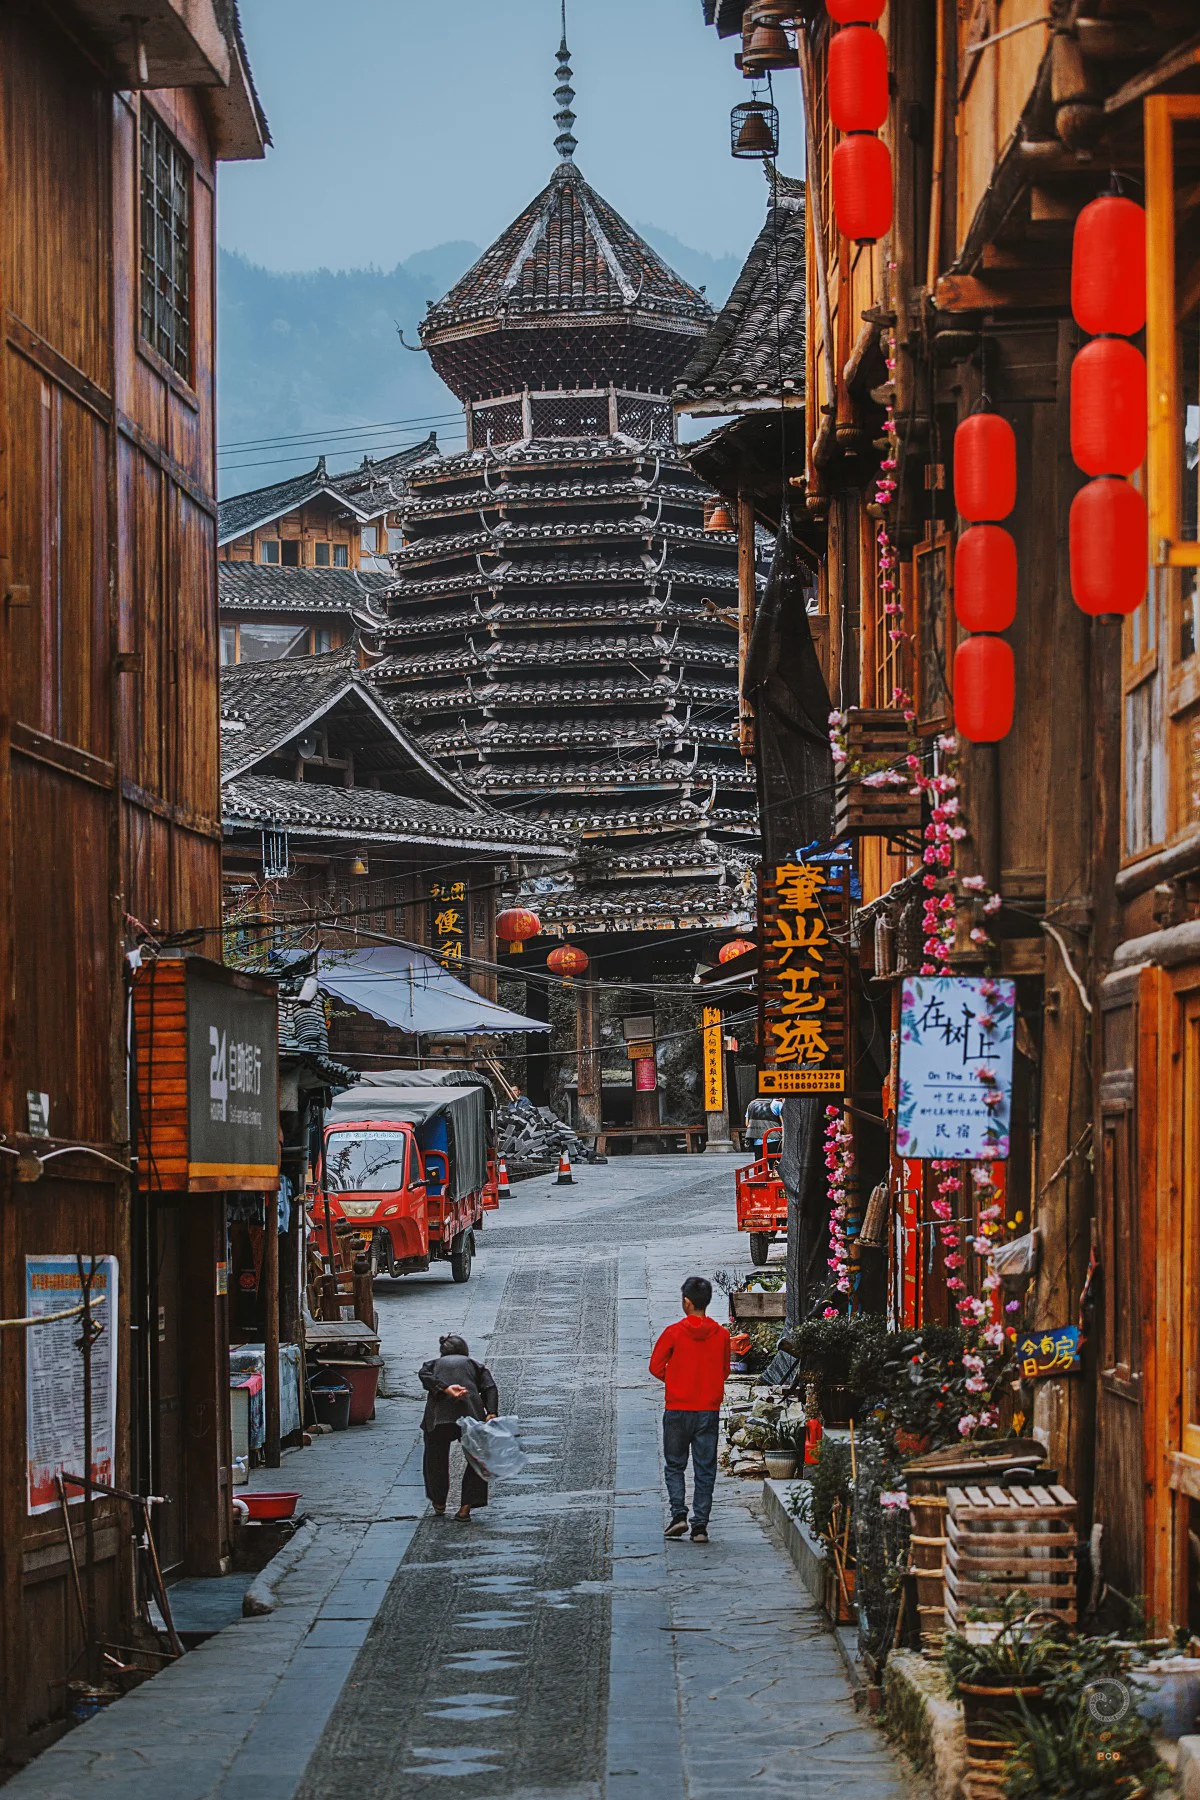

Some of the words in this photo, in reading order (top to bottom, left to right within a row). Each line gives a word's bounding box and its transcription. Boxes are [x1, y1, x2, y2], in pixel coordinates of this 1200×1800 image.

[772, 863, 829, 1065] 肇兴艺绣
[914, 995, 1000, 1065] 在树上
[928, 1071, 940, 1081] On
[946, 1071, 963, 1081] The
[936, 1123, 970, 1139] 民宿
